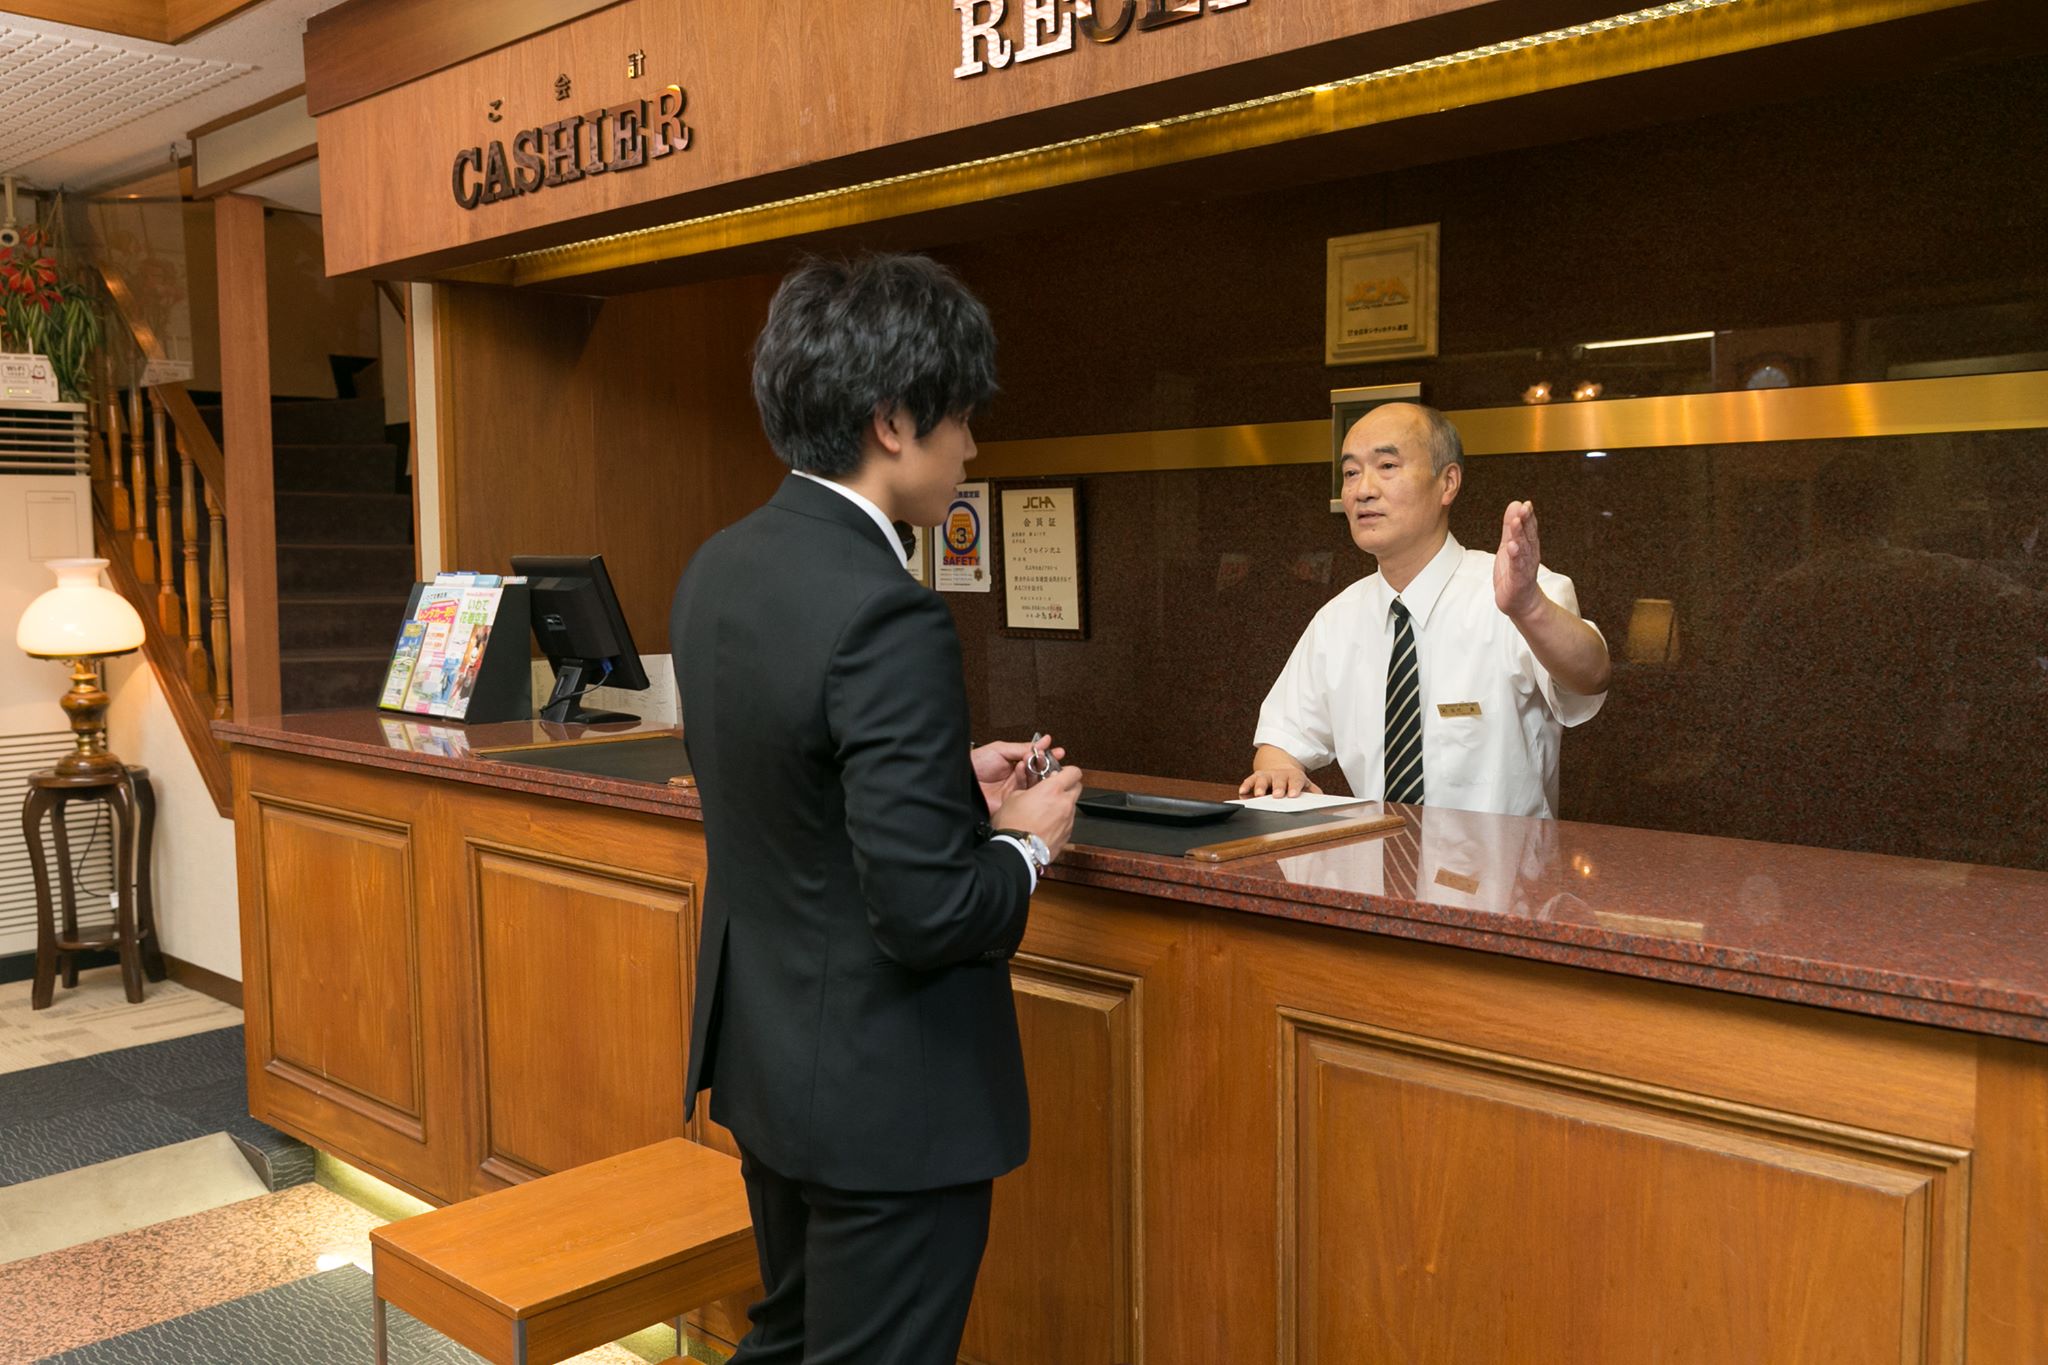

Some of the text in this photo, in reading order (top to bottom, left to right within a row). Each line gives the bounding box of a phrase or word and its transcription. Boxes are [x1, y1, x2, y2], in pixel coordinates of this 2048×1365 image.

[953, 0, 1249, 79] REC
[452, 84, 693, 210] CASHIER
[1022, 495, 1056, 509] JCHA
[955, 528, 967, 544] 3
[943, 556, 981, 566] SAFETY
